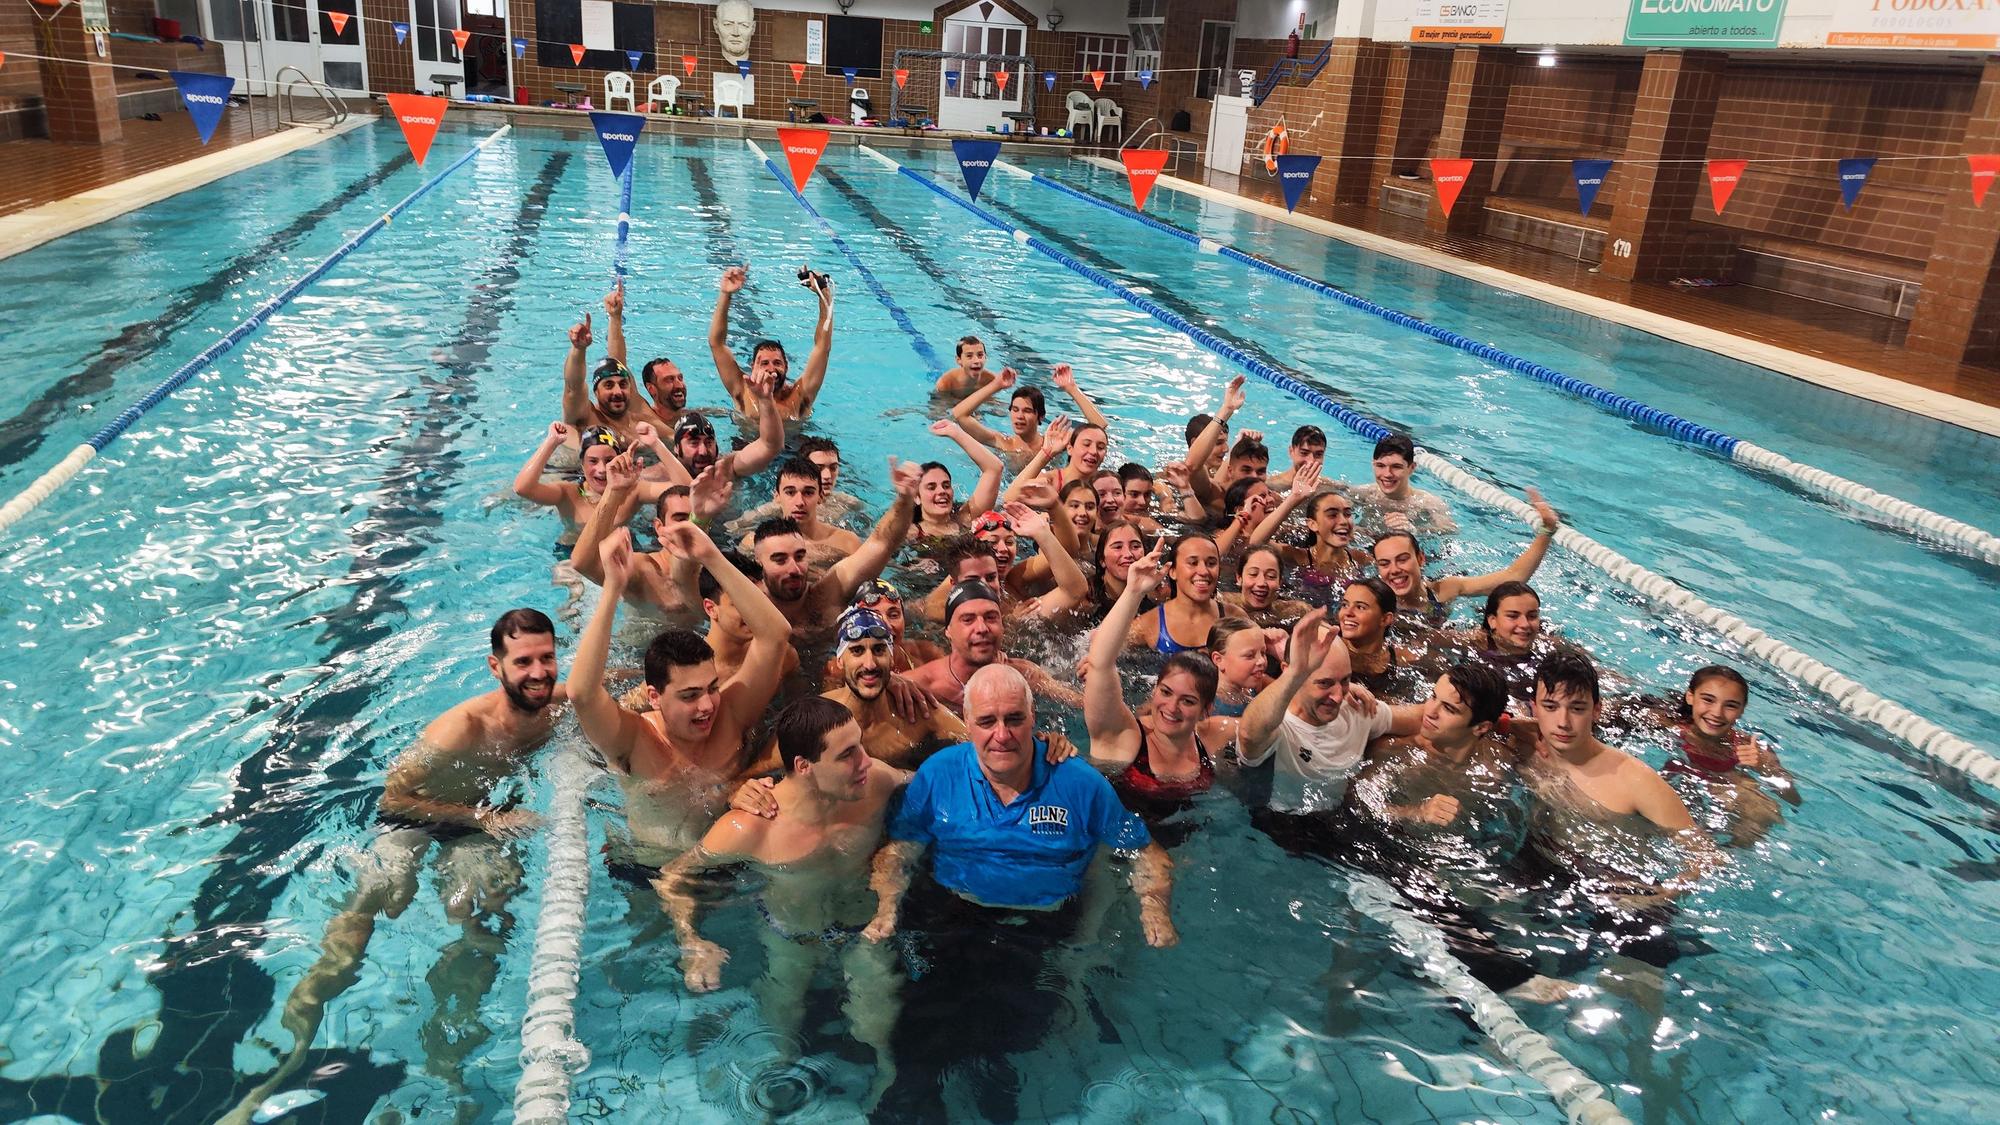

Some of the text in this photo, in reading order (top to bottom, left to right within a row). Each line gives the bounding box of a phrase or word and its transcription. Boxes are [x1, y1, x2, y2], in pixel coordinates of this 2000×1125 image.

[1419, 29, 1493, 41] El mejor precio garantizado
[1688, 26, 1720, 36] abierto
[1721, 28, 1728, 36] a
[186, 93, 223, 105] sport100
[402, 115, 436, 125] sport100
[602, 132, 634, 142] sport100
[788, 146, 818, 156] sport100
[962, 159, 989, 169] sport100
[1131, 168, 1158, 177] sport100
[1283, 172, 1309, 180] sport100
[1613, 238, 1631, 258] 170
[1029, 805, 1068, 826] LLNZ
